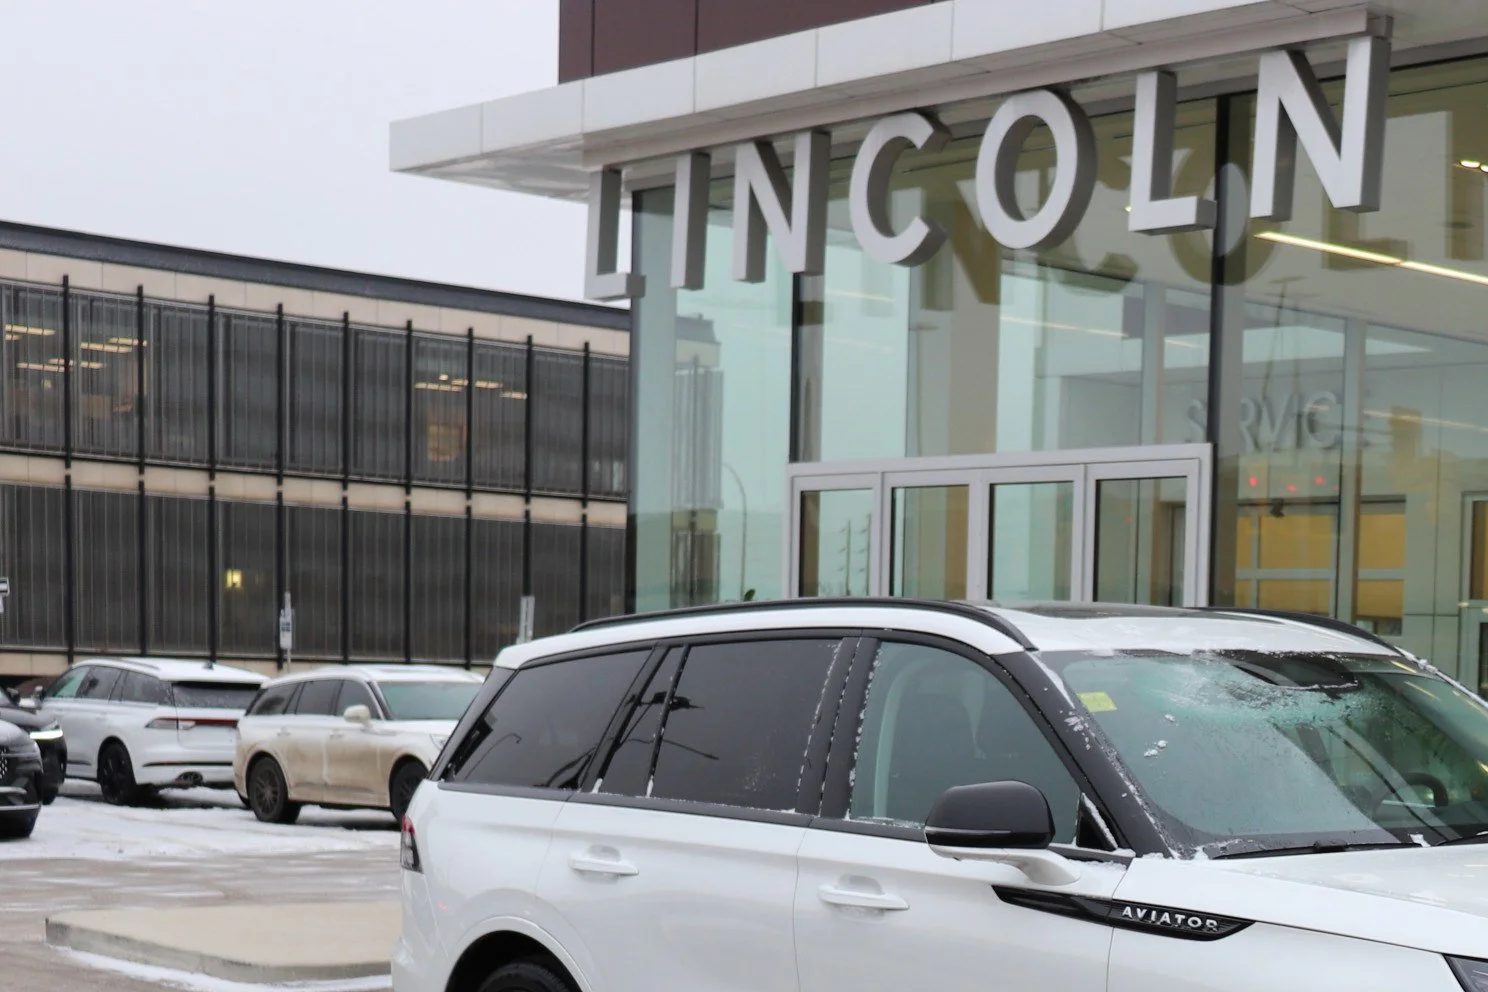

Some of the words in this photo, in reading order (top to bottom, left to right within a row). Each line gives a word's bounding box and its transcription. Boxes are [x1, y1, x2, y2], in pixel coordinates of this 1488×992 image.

[584, 34, 1393, 301] LINCOLN
[1186, 390, 1370, 453] SRVIC
[1122, 905, 1218, 931] AVIATOR
